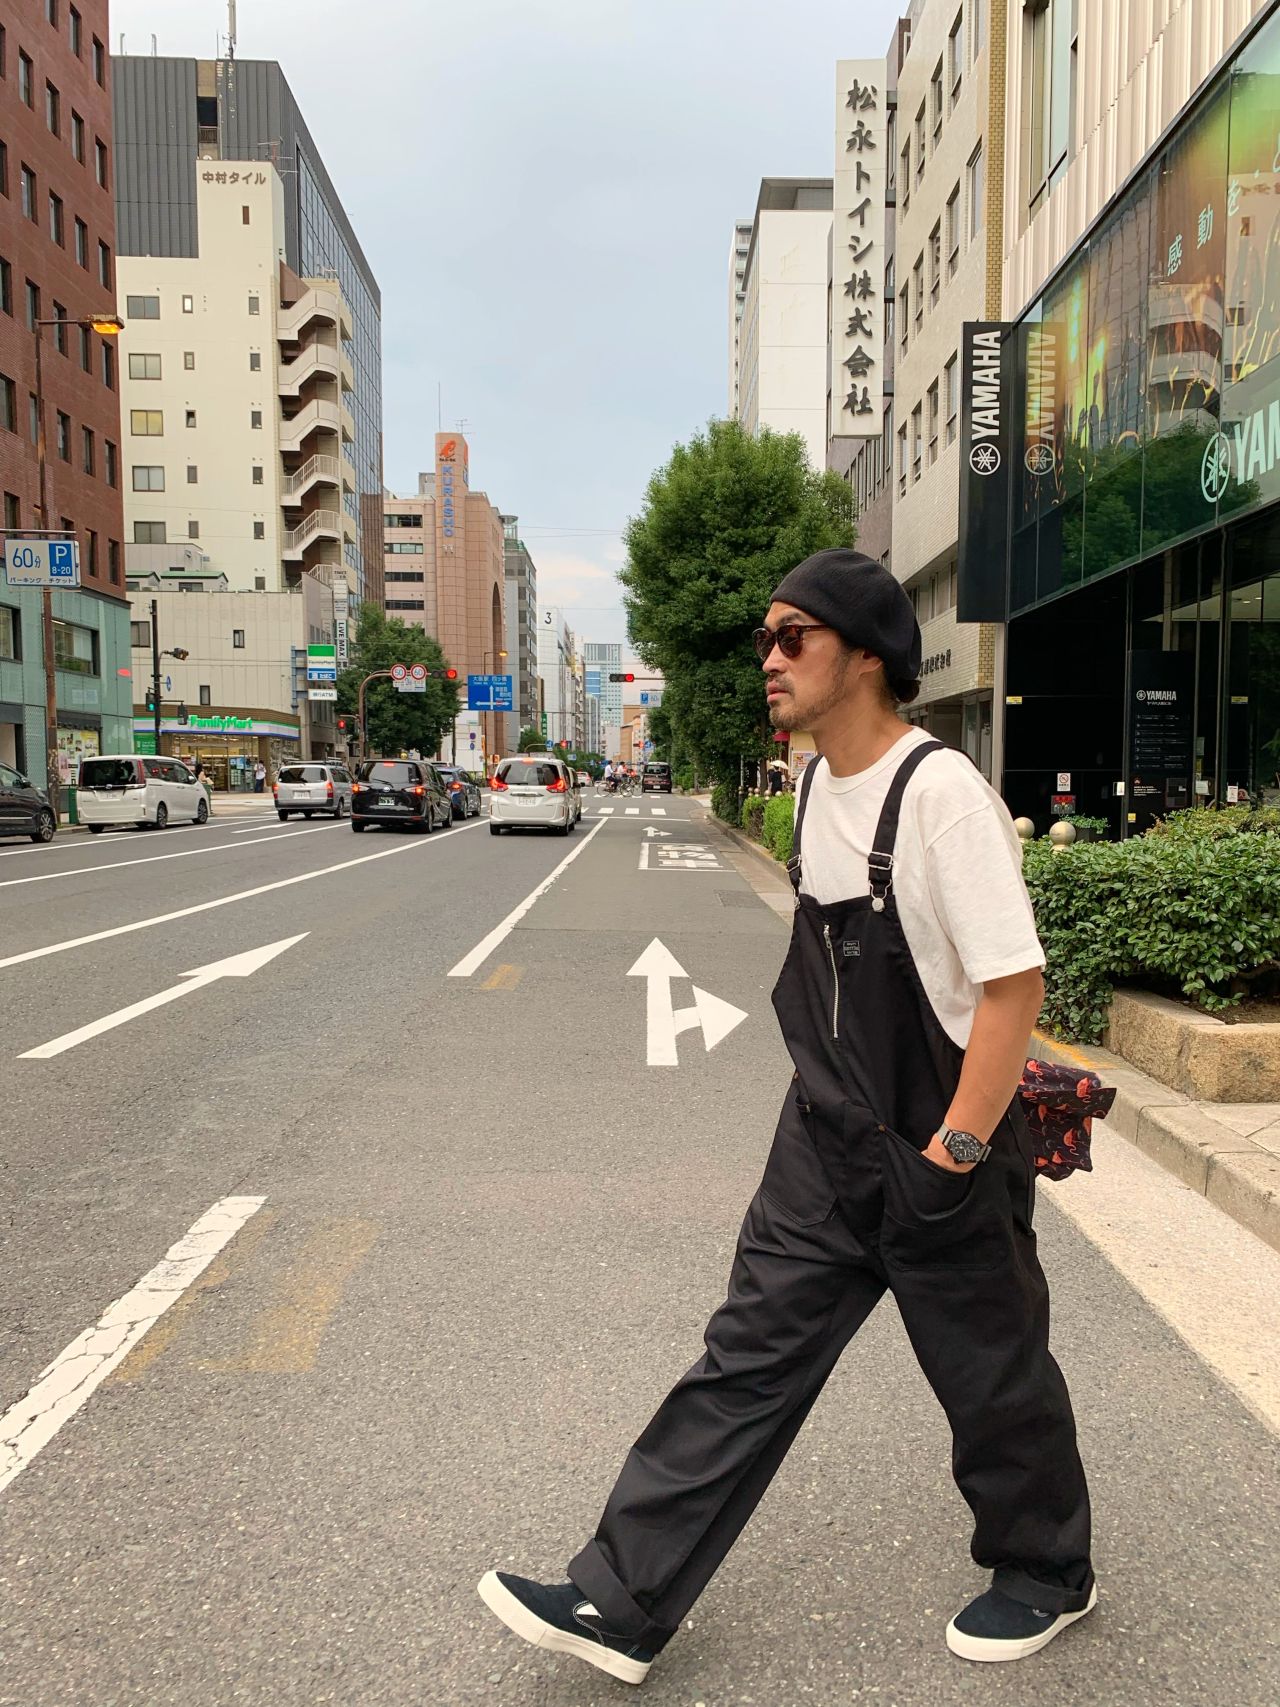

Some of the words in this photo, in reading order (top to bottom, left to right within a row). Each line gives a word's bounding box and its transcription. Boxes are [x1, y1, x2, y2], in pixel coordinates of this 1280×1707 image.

[202, 171, 266, 185] 中村タイル
[843, 78, 877, 416] 松永トイシ株式会社
[972, 331, 1001, 440] YAMAHA
[13, 548, 41, 568] 60分
[56, 545, 67, 564] P
[52, 566, 71, 575] 8-20
[544, 612, 552, 624] 3
[1146, 691, 1177, 701] YAMAHA
[188, 714, 252, 732] FamilyMart
